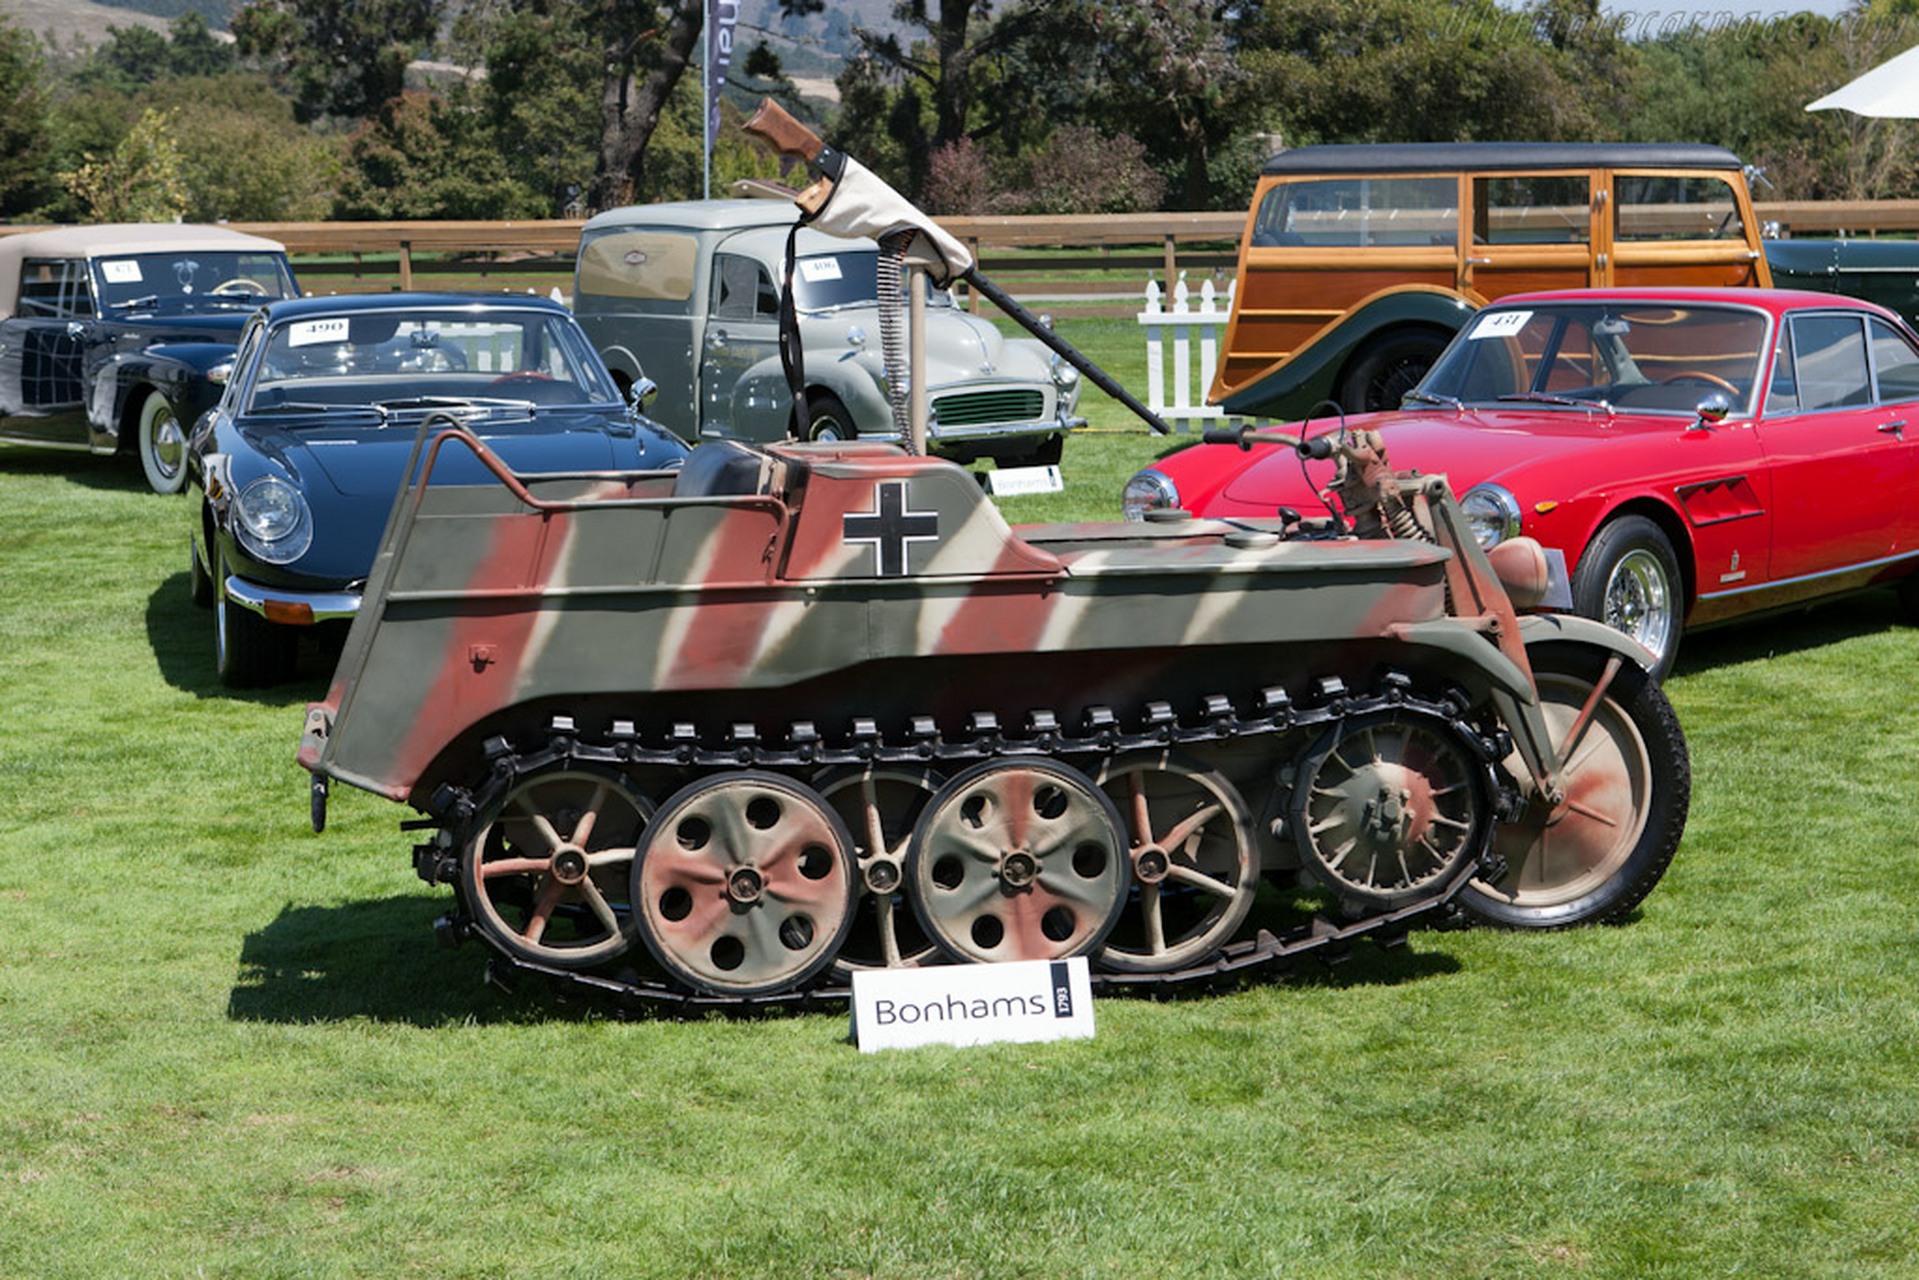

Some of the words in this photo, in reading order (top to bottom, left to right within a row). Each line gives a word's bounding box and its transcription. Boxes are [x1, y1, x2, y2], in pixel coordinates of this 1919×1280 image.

[305, 322, 344, 333] 490
[875, 993, 1046, 1025] Bonhams
[1056, 987, 1070, 1013] 1793
